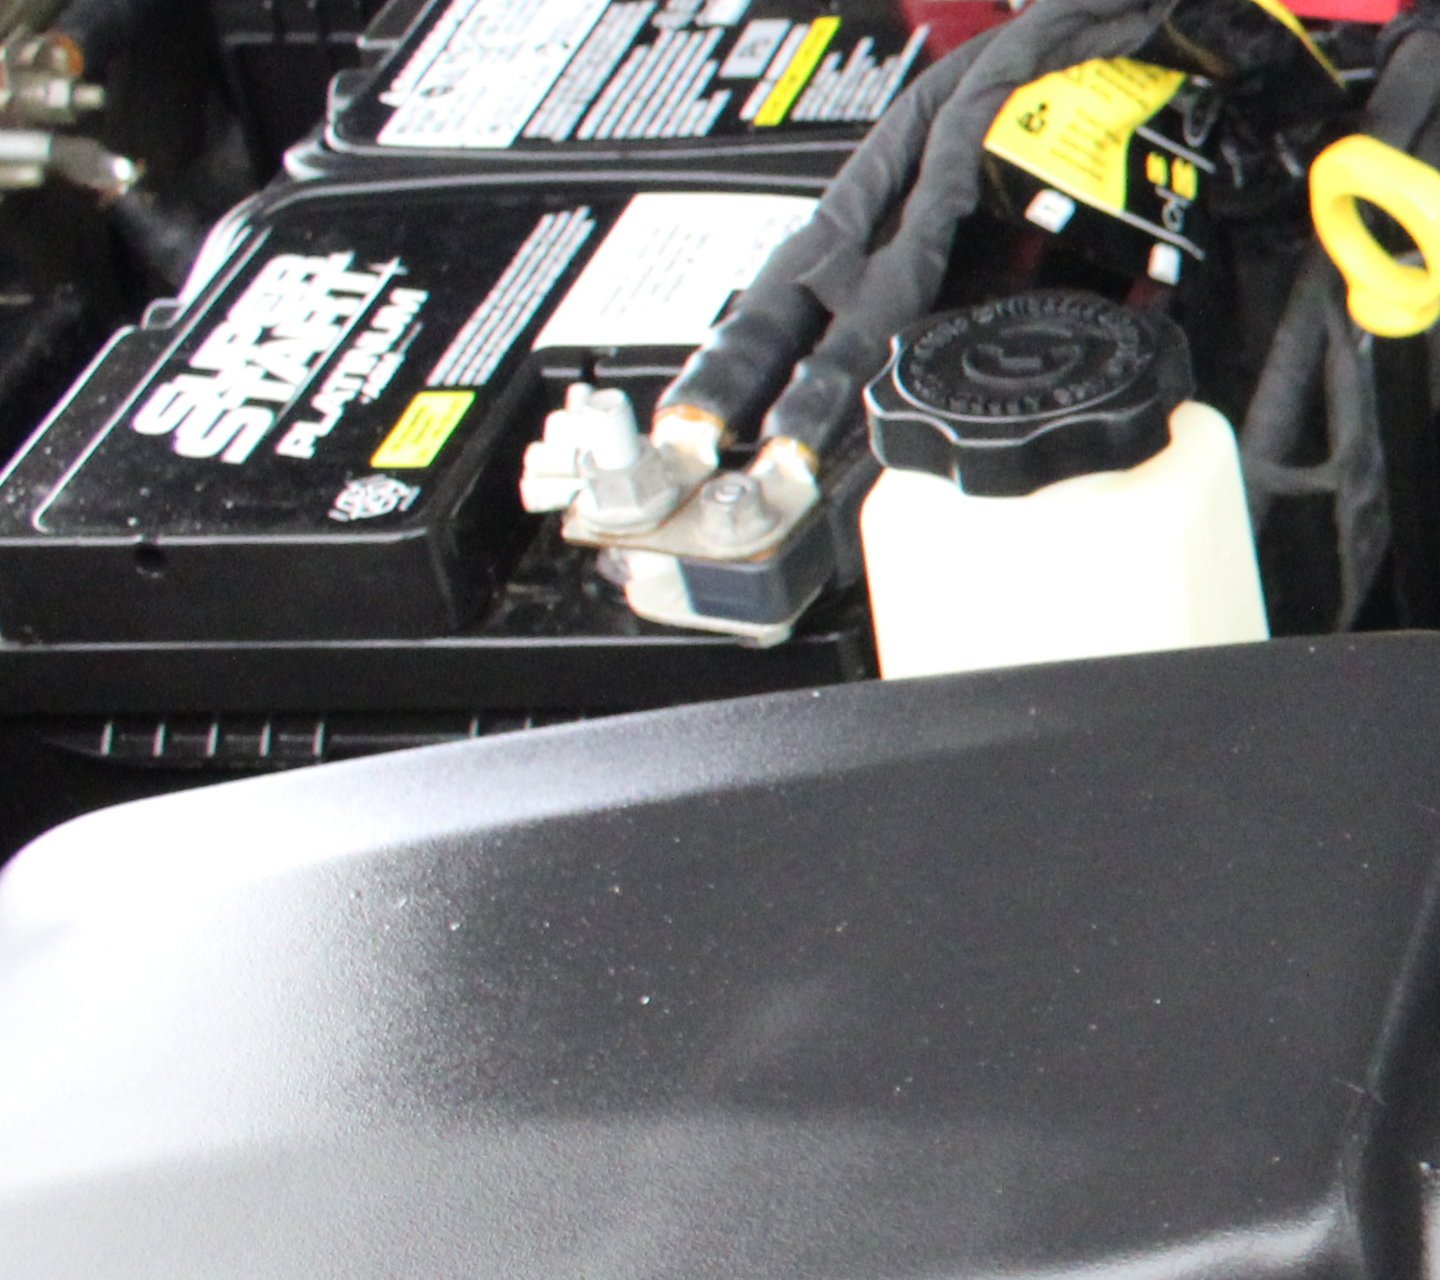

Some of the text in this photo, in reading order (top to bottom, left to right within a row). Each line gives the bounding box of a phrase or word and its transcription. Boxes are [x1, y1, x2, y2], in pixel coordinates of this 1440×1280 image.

[132, 250, 354, 435] SUPER
[173, 268, 381, 464] START
[275, 288, 430, 460] PLATINUM
